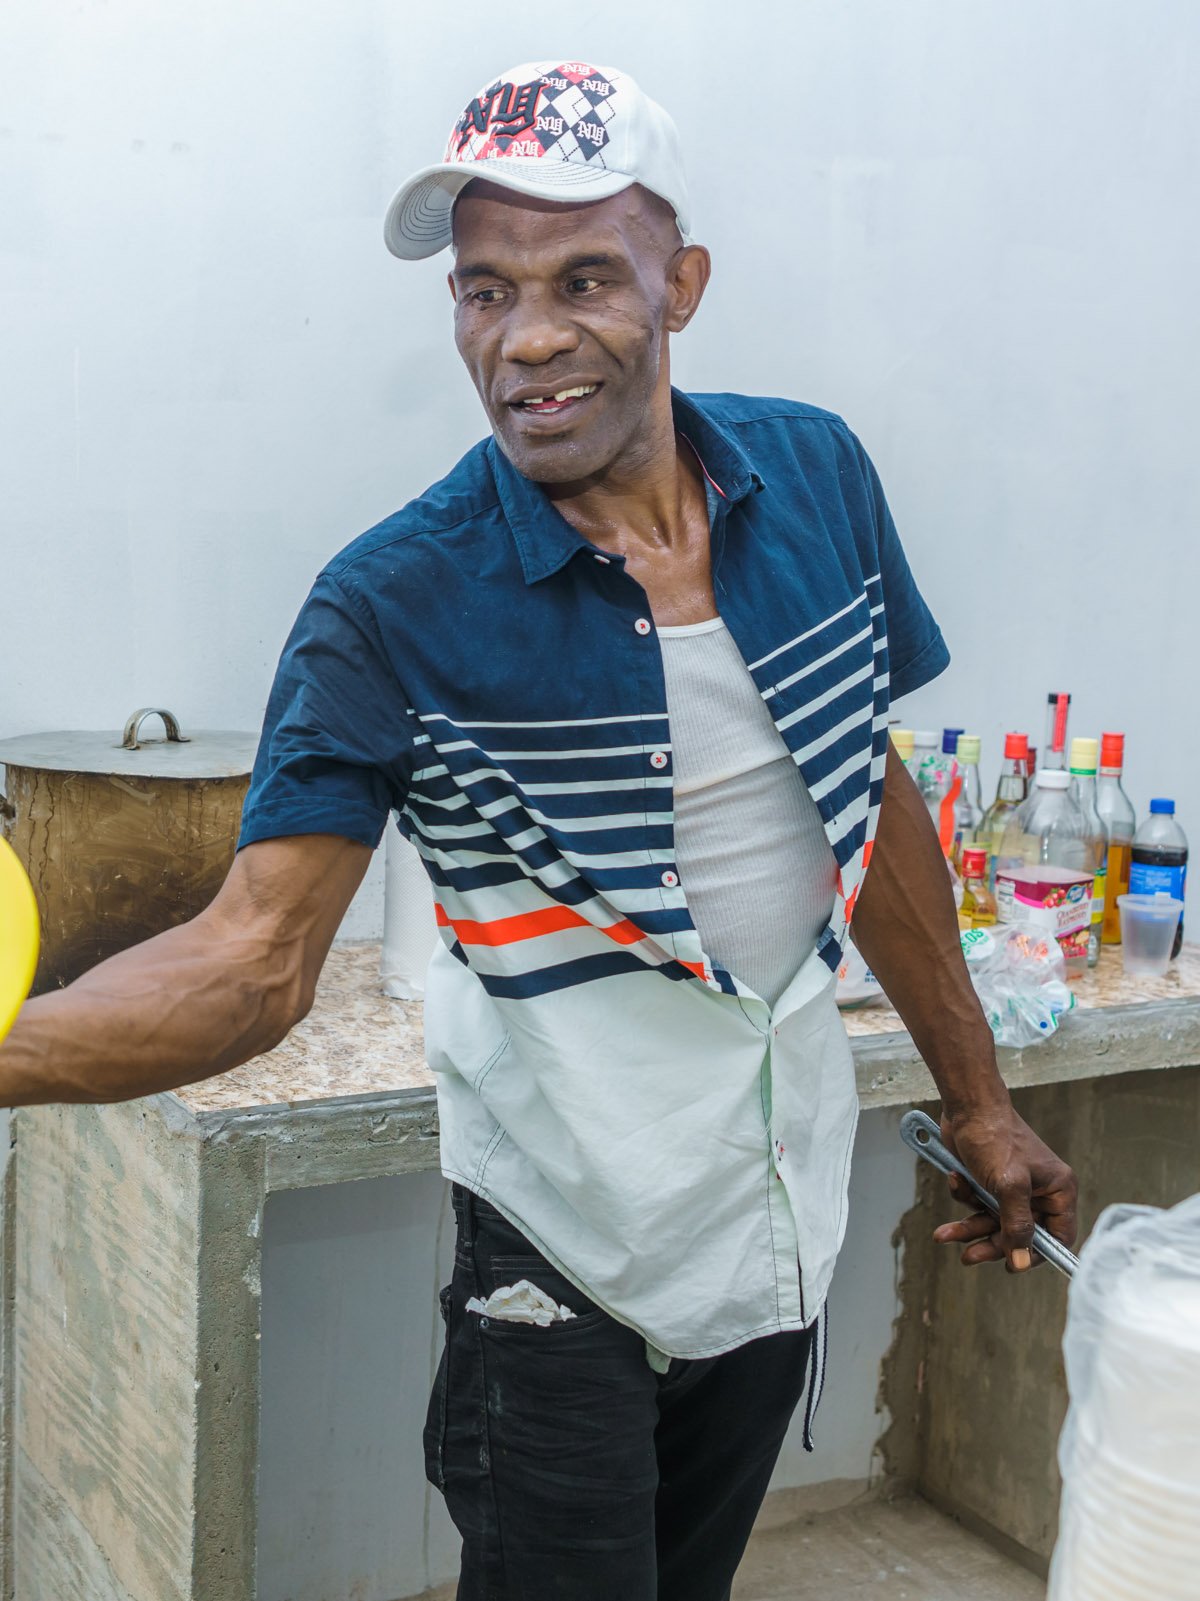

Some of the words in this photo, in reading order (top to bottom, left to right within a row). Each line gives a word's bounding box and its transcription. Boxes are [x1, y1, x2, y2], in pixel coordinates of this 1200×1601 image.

[561, 63, 591, 76] NY
[581, 79, 611, 96] NY
[457, 81, 548, 152] NY
[535, 116, 565, 136] NY
[577, 121, 605, 147] NY
